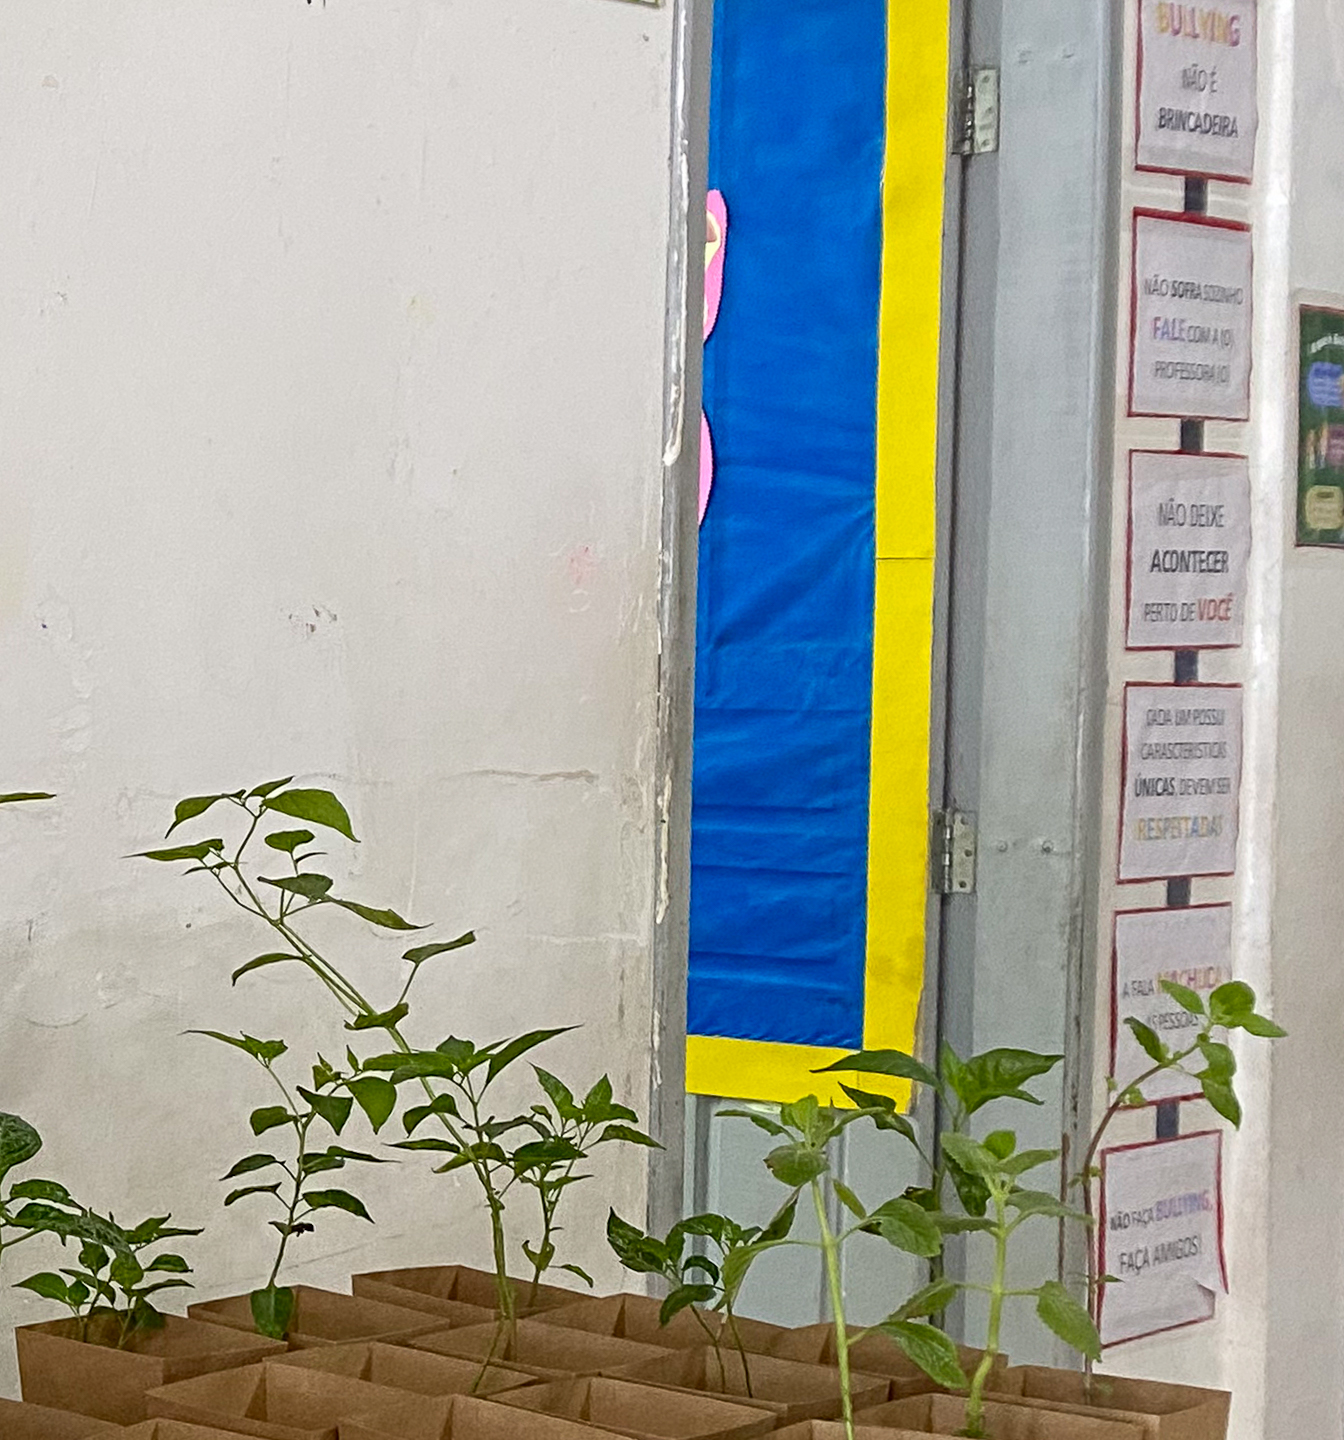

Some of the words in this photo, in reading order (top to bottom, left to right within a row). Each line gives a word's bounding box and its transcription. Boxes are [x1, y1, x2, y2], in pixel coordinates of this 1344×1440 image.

[1181, 63, 1207, 92] NÃO
[1157, 107, 1238, 138] BRINCADEIRA
[1144, 273, 1169, 298] NÃO
[1171, 280, 1201, 300] SOFRA
[1153, 316, 1186, 342] FALE
[1158, 498, 1186, 528] NÃO
[1190, 503, 1226, 528] DEIXE
[1150, 549, 1230, 574] ACONTECER
[1143, 601, 1178, 622] PERTO
[1180, 601, 1196, 622] DE
[1196, 592, 1235, 622] VOCÊ
[1110, 1210, 1130, 1231] NÃO
[1118, 1245, 1151, 1276] FAÇA
